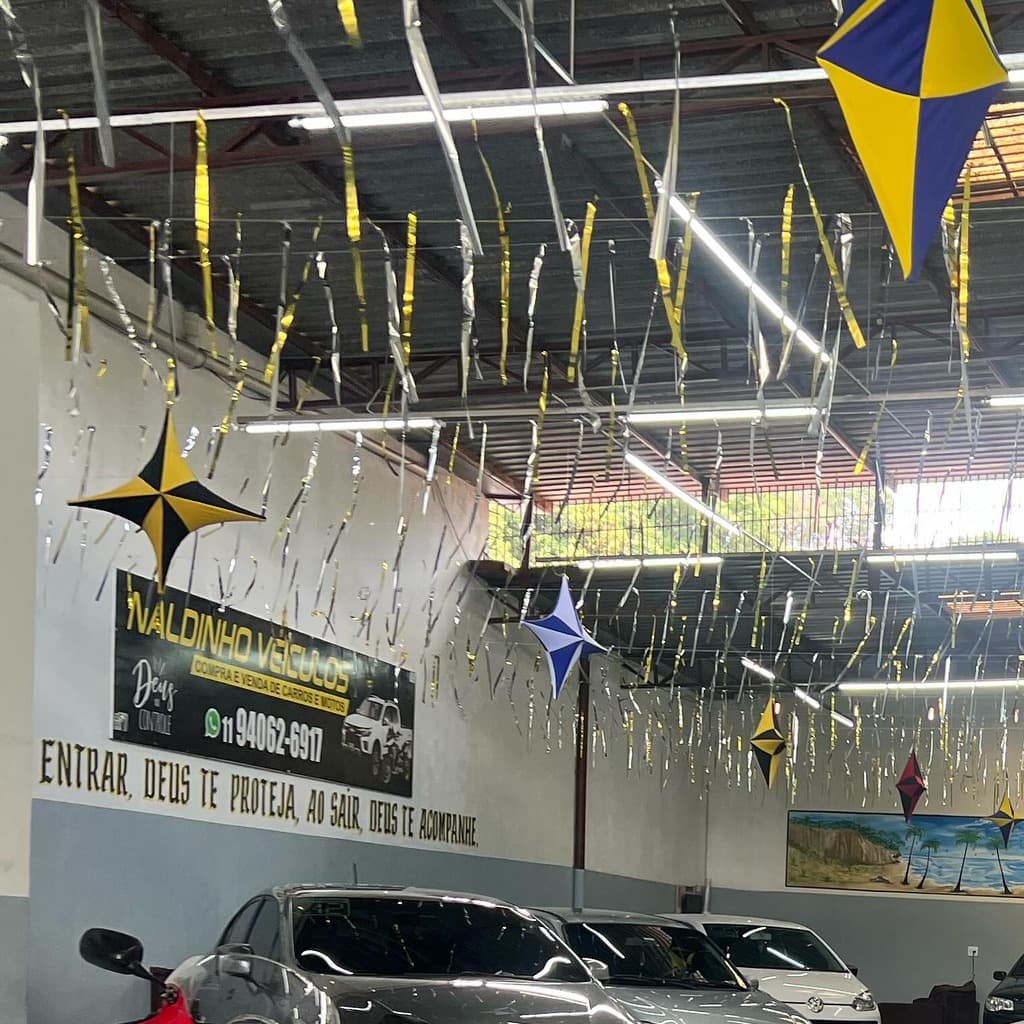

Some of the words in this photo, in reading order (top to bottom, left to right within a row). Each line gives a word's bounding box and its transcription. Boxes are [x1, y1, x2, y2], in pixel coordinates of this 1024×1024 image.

[127, 591, 252, 663] NALDINHO
[194, 660, 232, 681] COMPRA
[235, 671, 240, 683] E
[241, 672, 269, 693] VENDA
[270, 680, 281, 695] DE
[281, 685, 313, 706] CARROS
[314, 694, 320, 706] E
[320, 696, 346, 713] MOTOS
[222, 716, 233, 744] 11
[236, 707, 323, 763] 94062-6917
[39, 739, 133, 801] ENTRAR,
[144, 757, 190, 805] DEUS
[200, 768, 219, 809] TE
[231, 773, 300, 827] PROTEJA,
[307, 788, 325, 825] AO
[369, 799, 398, 834] DEUS
[402, 804, 416, 838] TE
[419, 808, 480, 848] ACOMPANHE.
